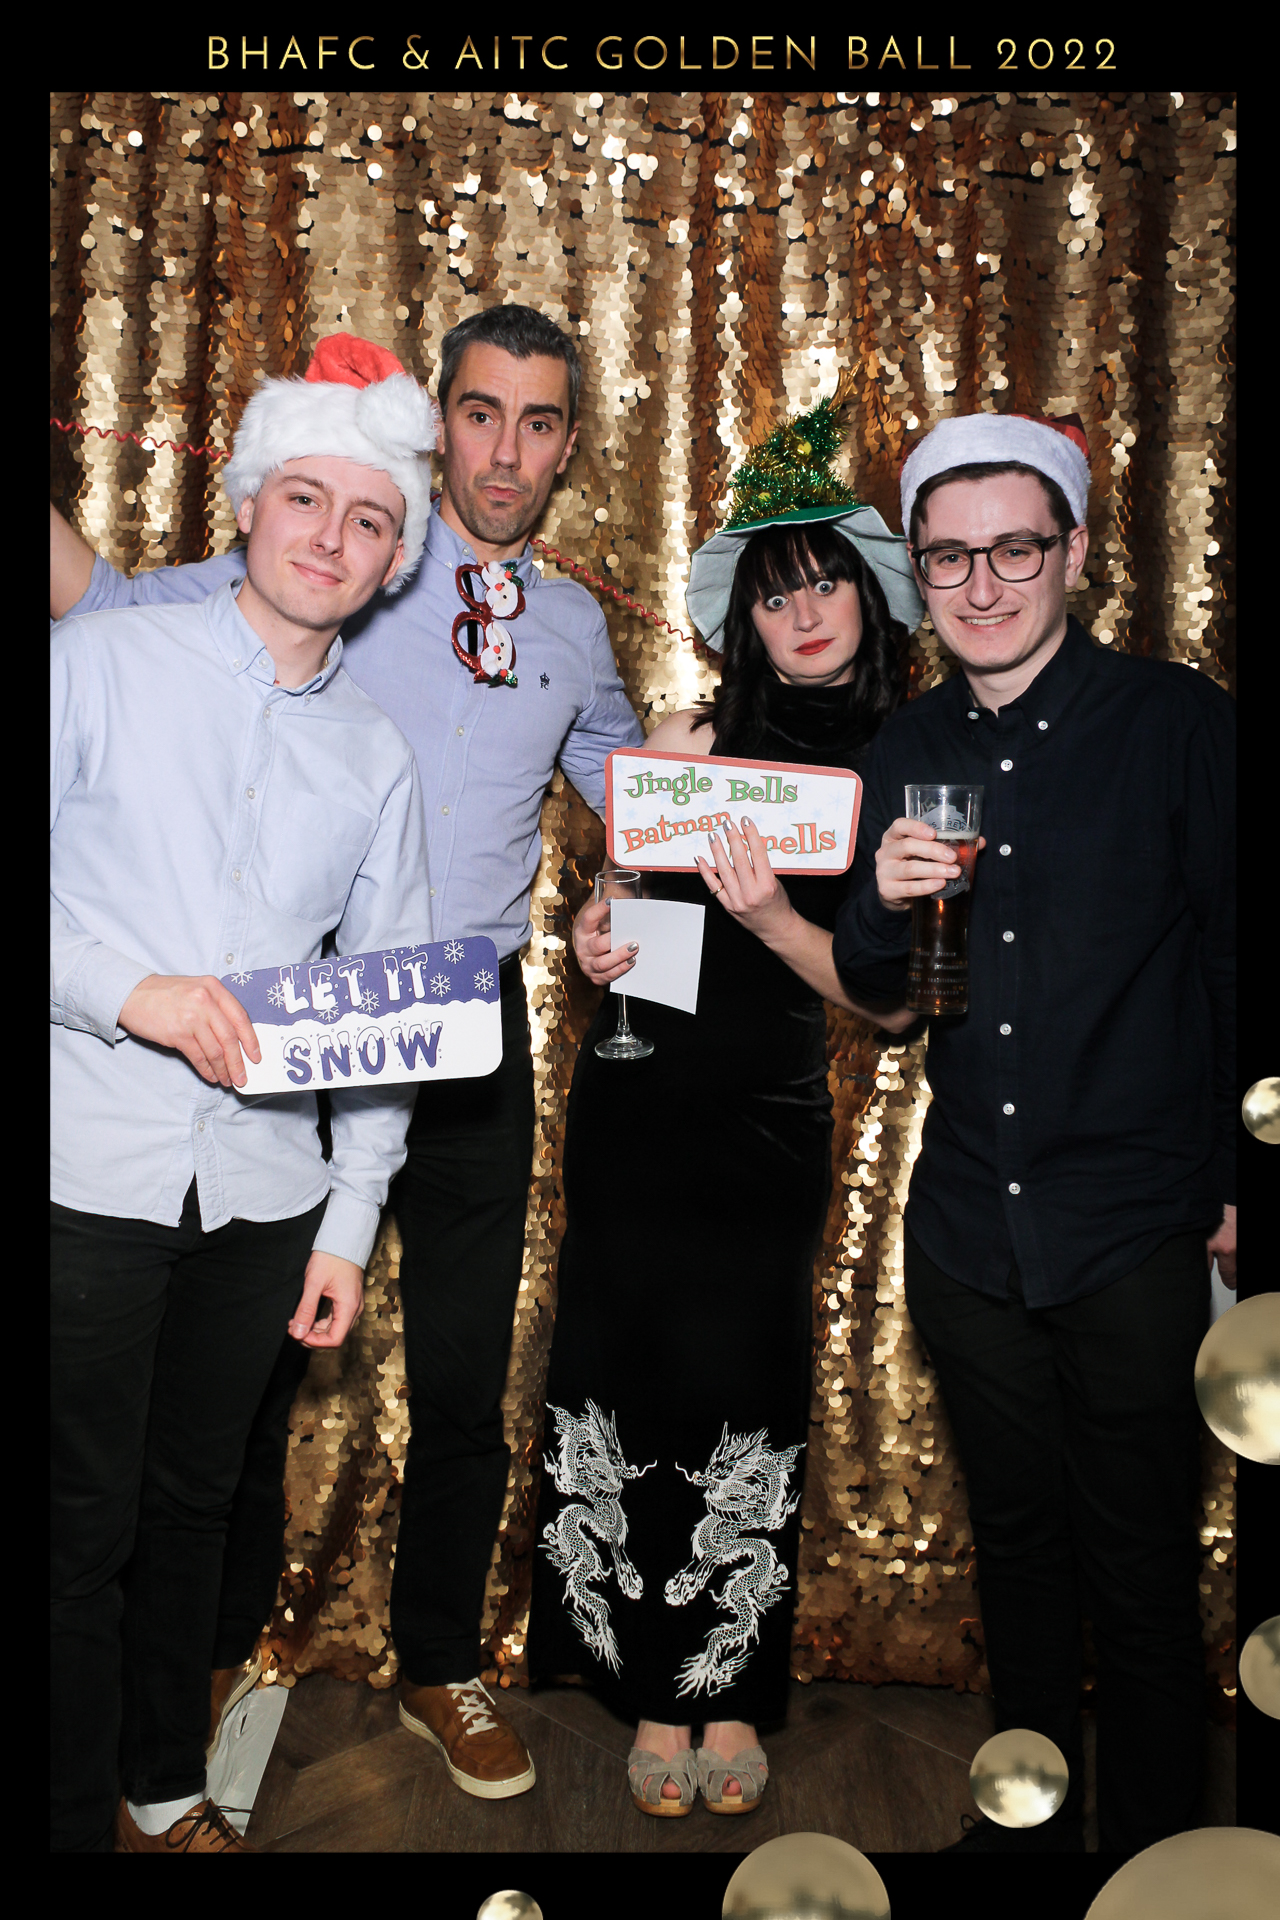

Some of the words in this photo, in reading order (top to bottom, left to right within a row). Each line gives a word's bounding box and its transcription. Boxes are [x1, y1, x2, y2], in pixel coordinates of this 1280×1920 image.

[623, 766, 714, 806] Jingle
[725, 775, 799, 804] Bells
[618, 811, 732, 854] Batman
[727, 822, 837, 858] mells
[279, 959, 366, 1014] LET
[382, 951, 429, 1001] IT
[283, 1021, 443, 1086] SNOW
